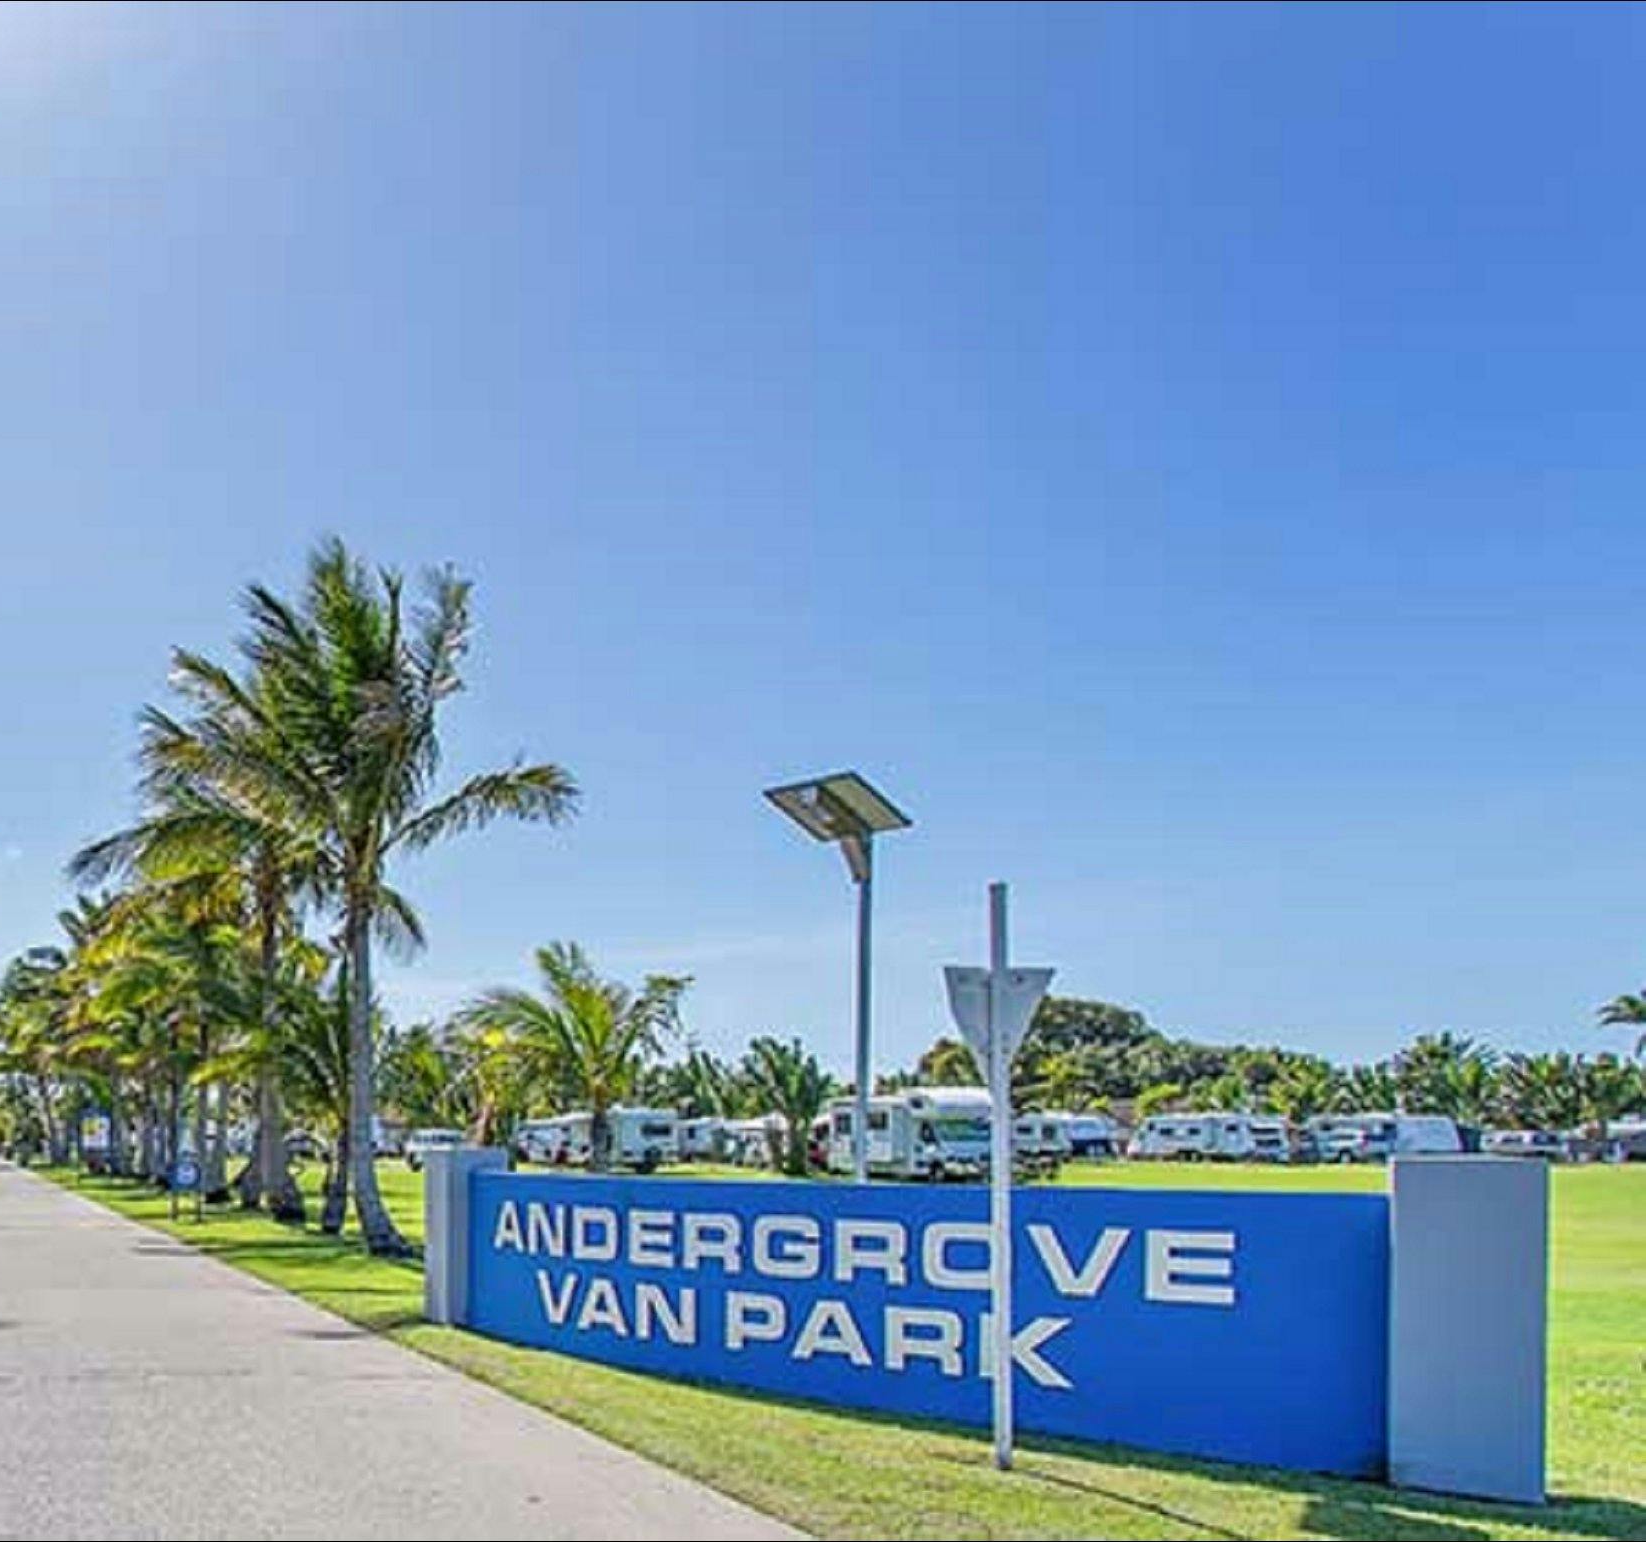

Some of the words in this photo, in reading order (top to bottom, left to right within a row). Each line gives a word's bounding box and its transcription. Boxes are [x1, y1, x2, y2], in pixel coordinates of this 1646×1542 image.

[493, 1200, 1236, 1305] ANDERGROVE
[537, 1269, 697, 1345] VAN
[725, 1290, 1074, 1389] PARK
